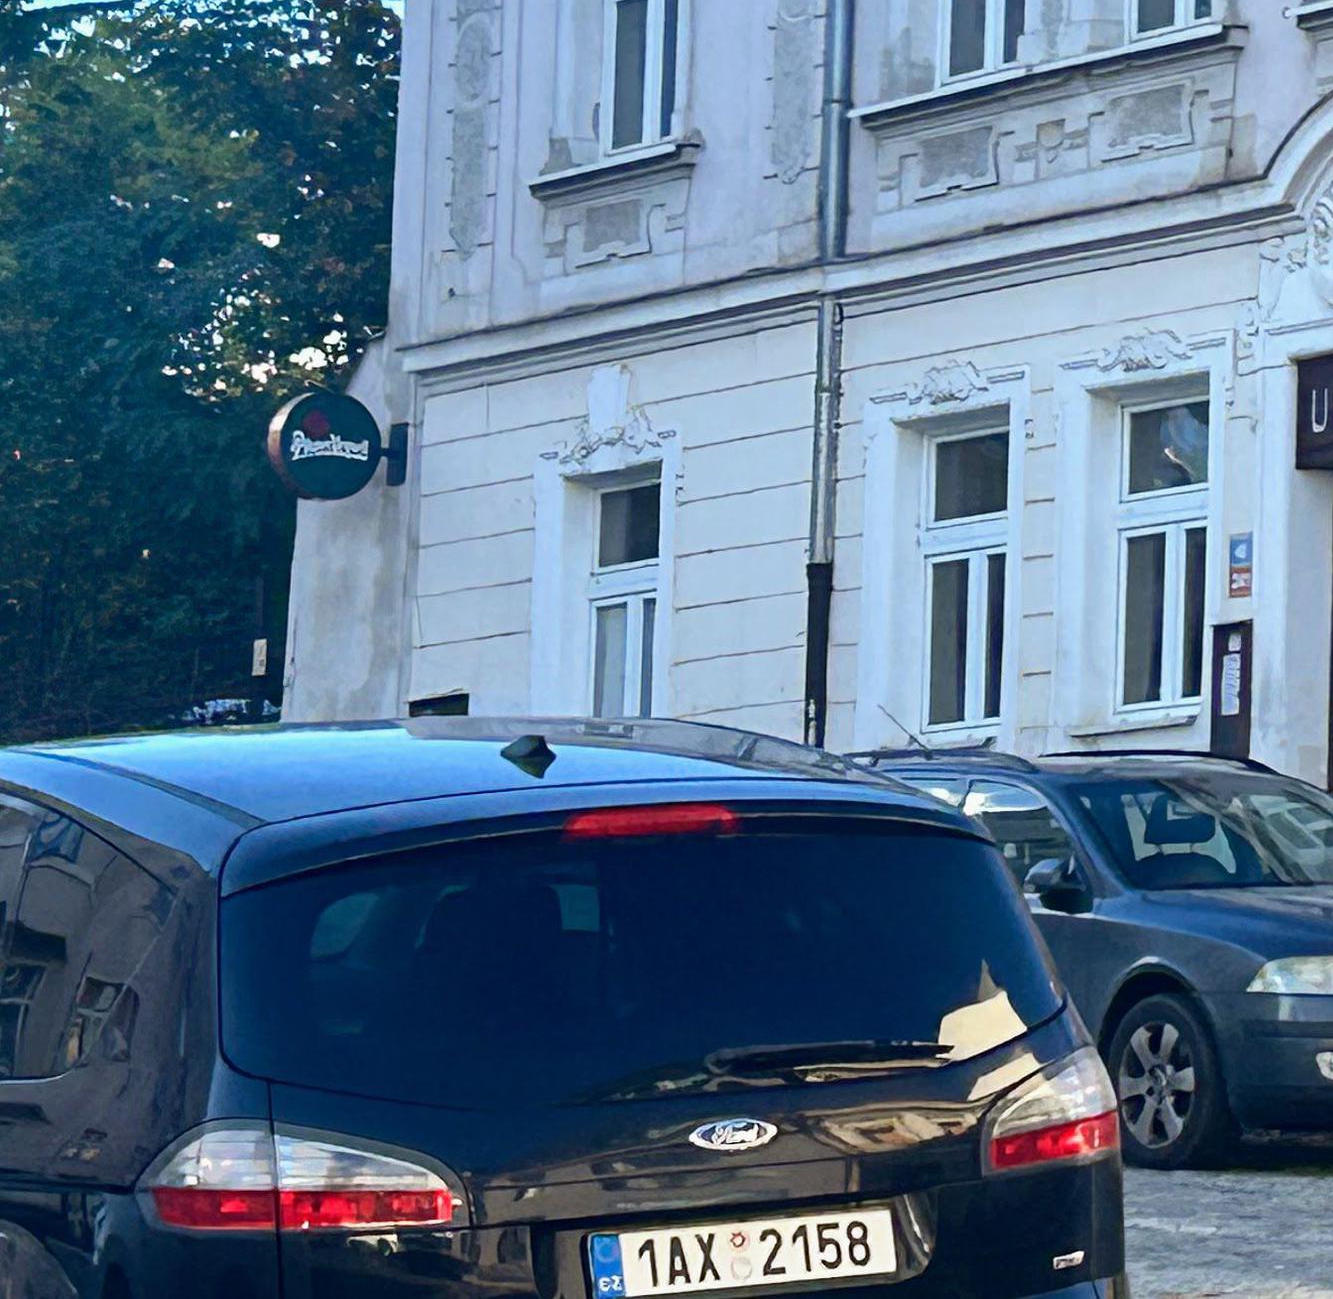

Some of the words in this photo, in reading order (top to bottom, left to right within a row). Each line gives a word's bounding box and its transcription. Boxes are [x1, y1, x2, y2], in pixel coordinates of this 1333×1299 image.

[1311, 387, 1328, 433] U
[638, 1232, 721, 1288] 1AX
[759, 1220, 871, 1277] 2158
